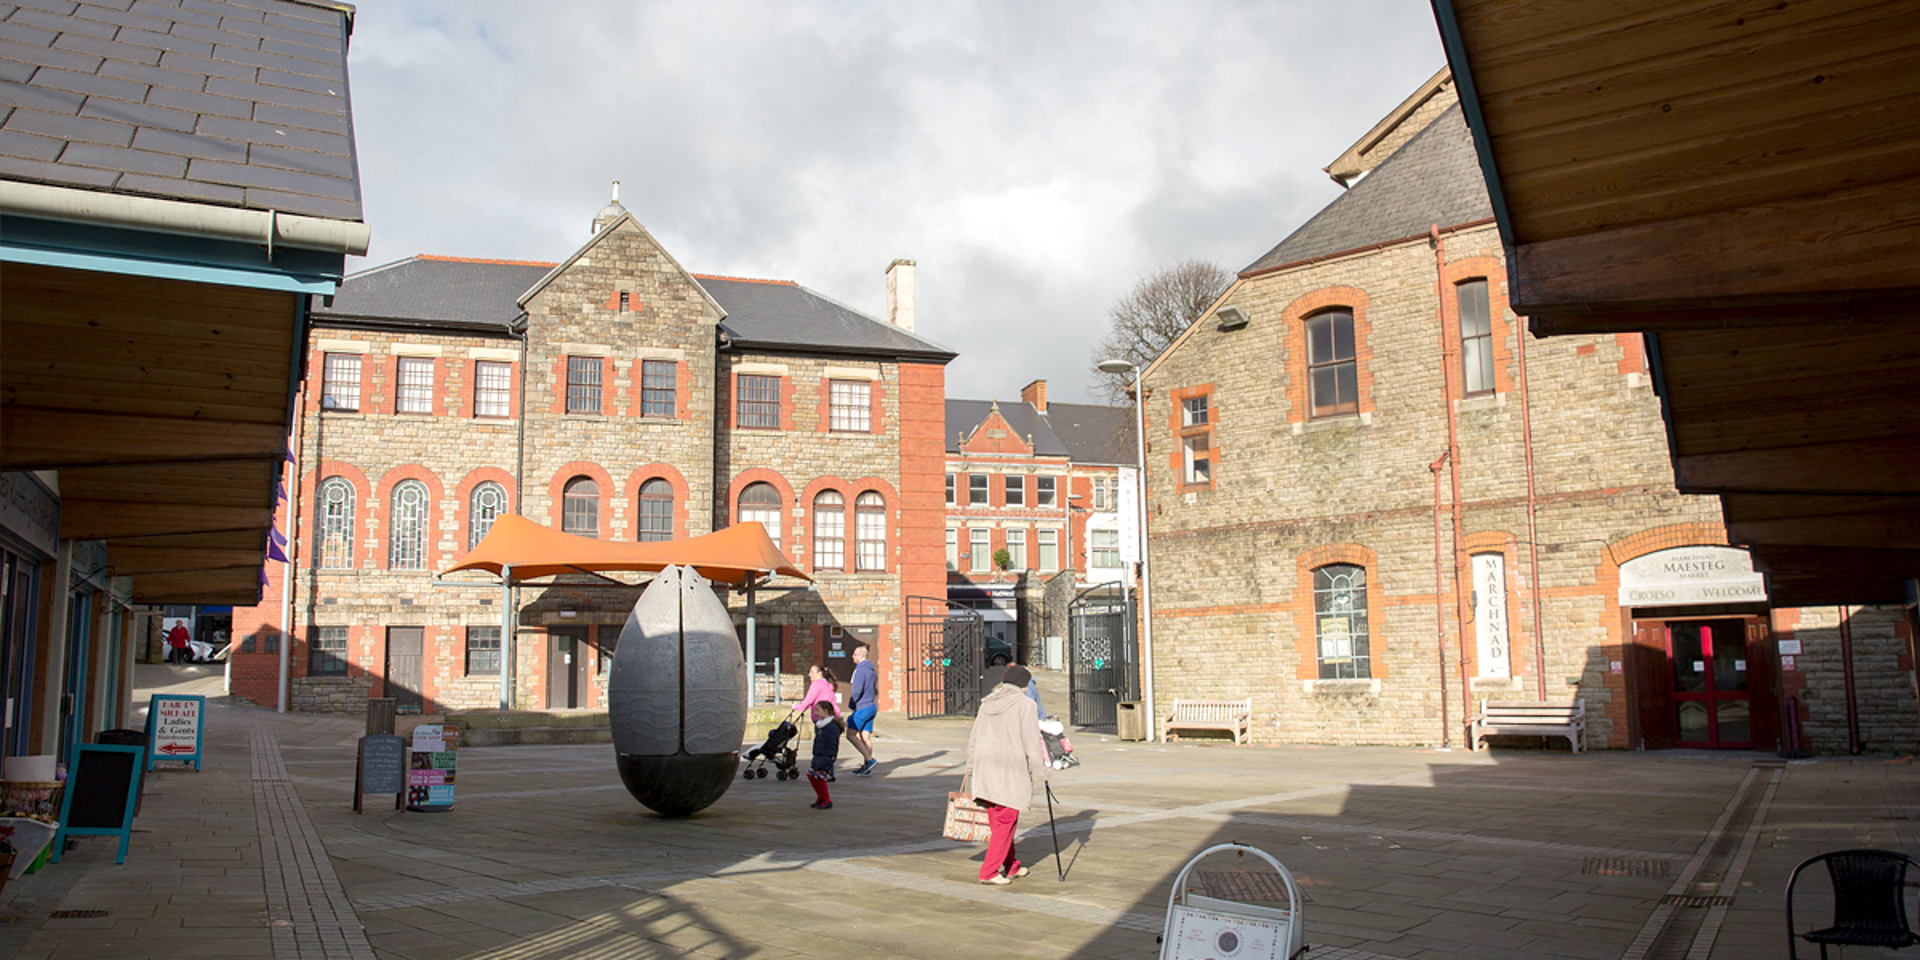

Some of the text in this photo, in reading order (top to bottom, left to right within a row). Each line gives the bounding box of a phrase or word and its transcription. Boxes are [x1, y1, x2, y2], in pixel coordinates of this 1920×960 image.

[1671, 553, 1716, 561] MARCHNAD
[1663, 559, 1726, 573] MAESTEG
[1628, 586, 1762, 601] CROESO WELCOME
[1485, 559, 1502, 658] MARCHNAD
[158, 726, 195, 734] & Gents
